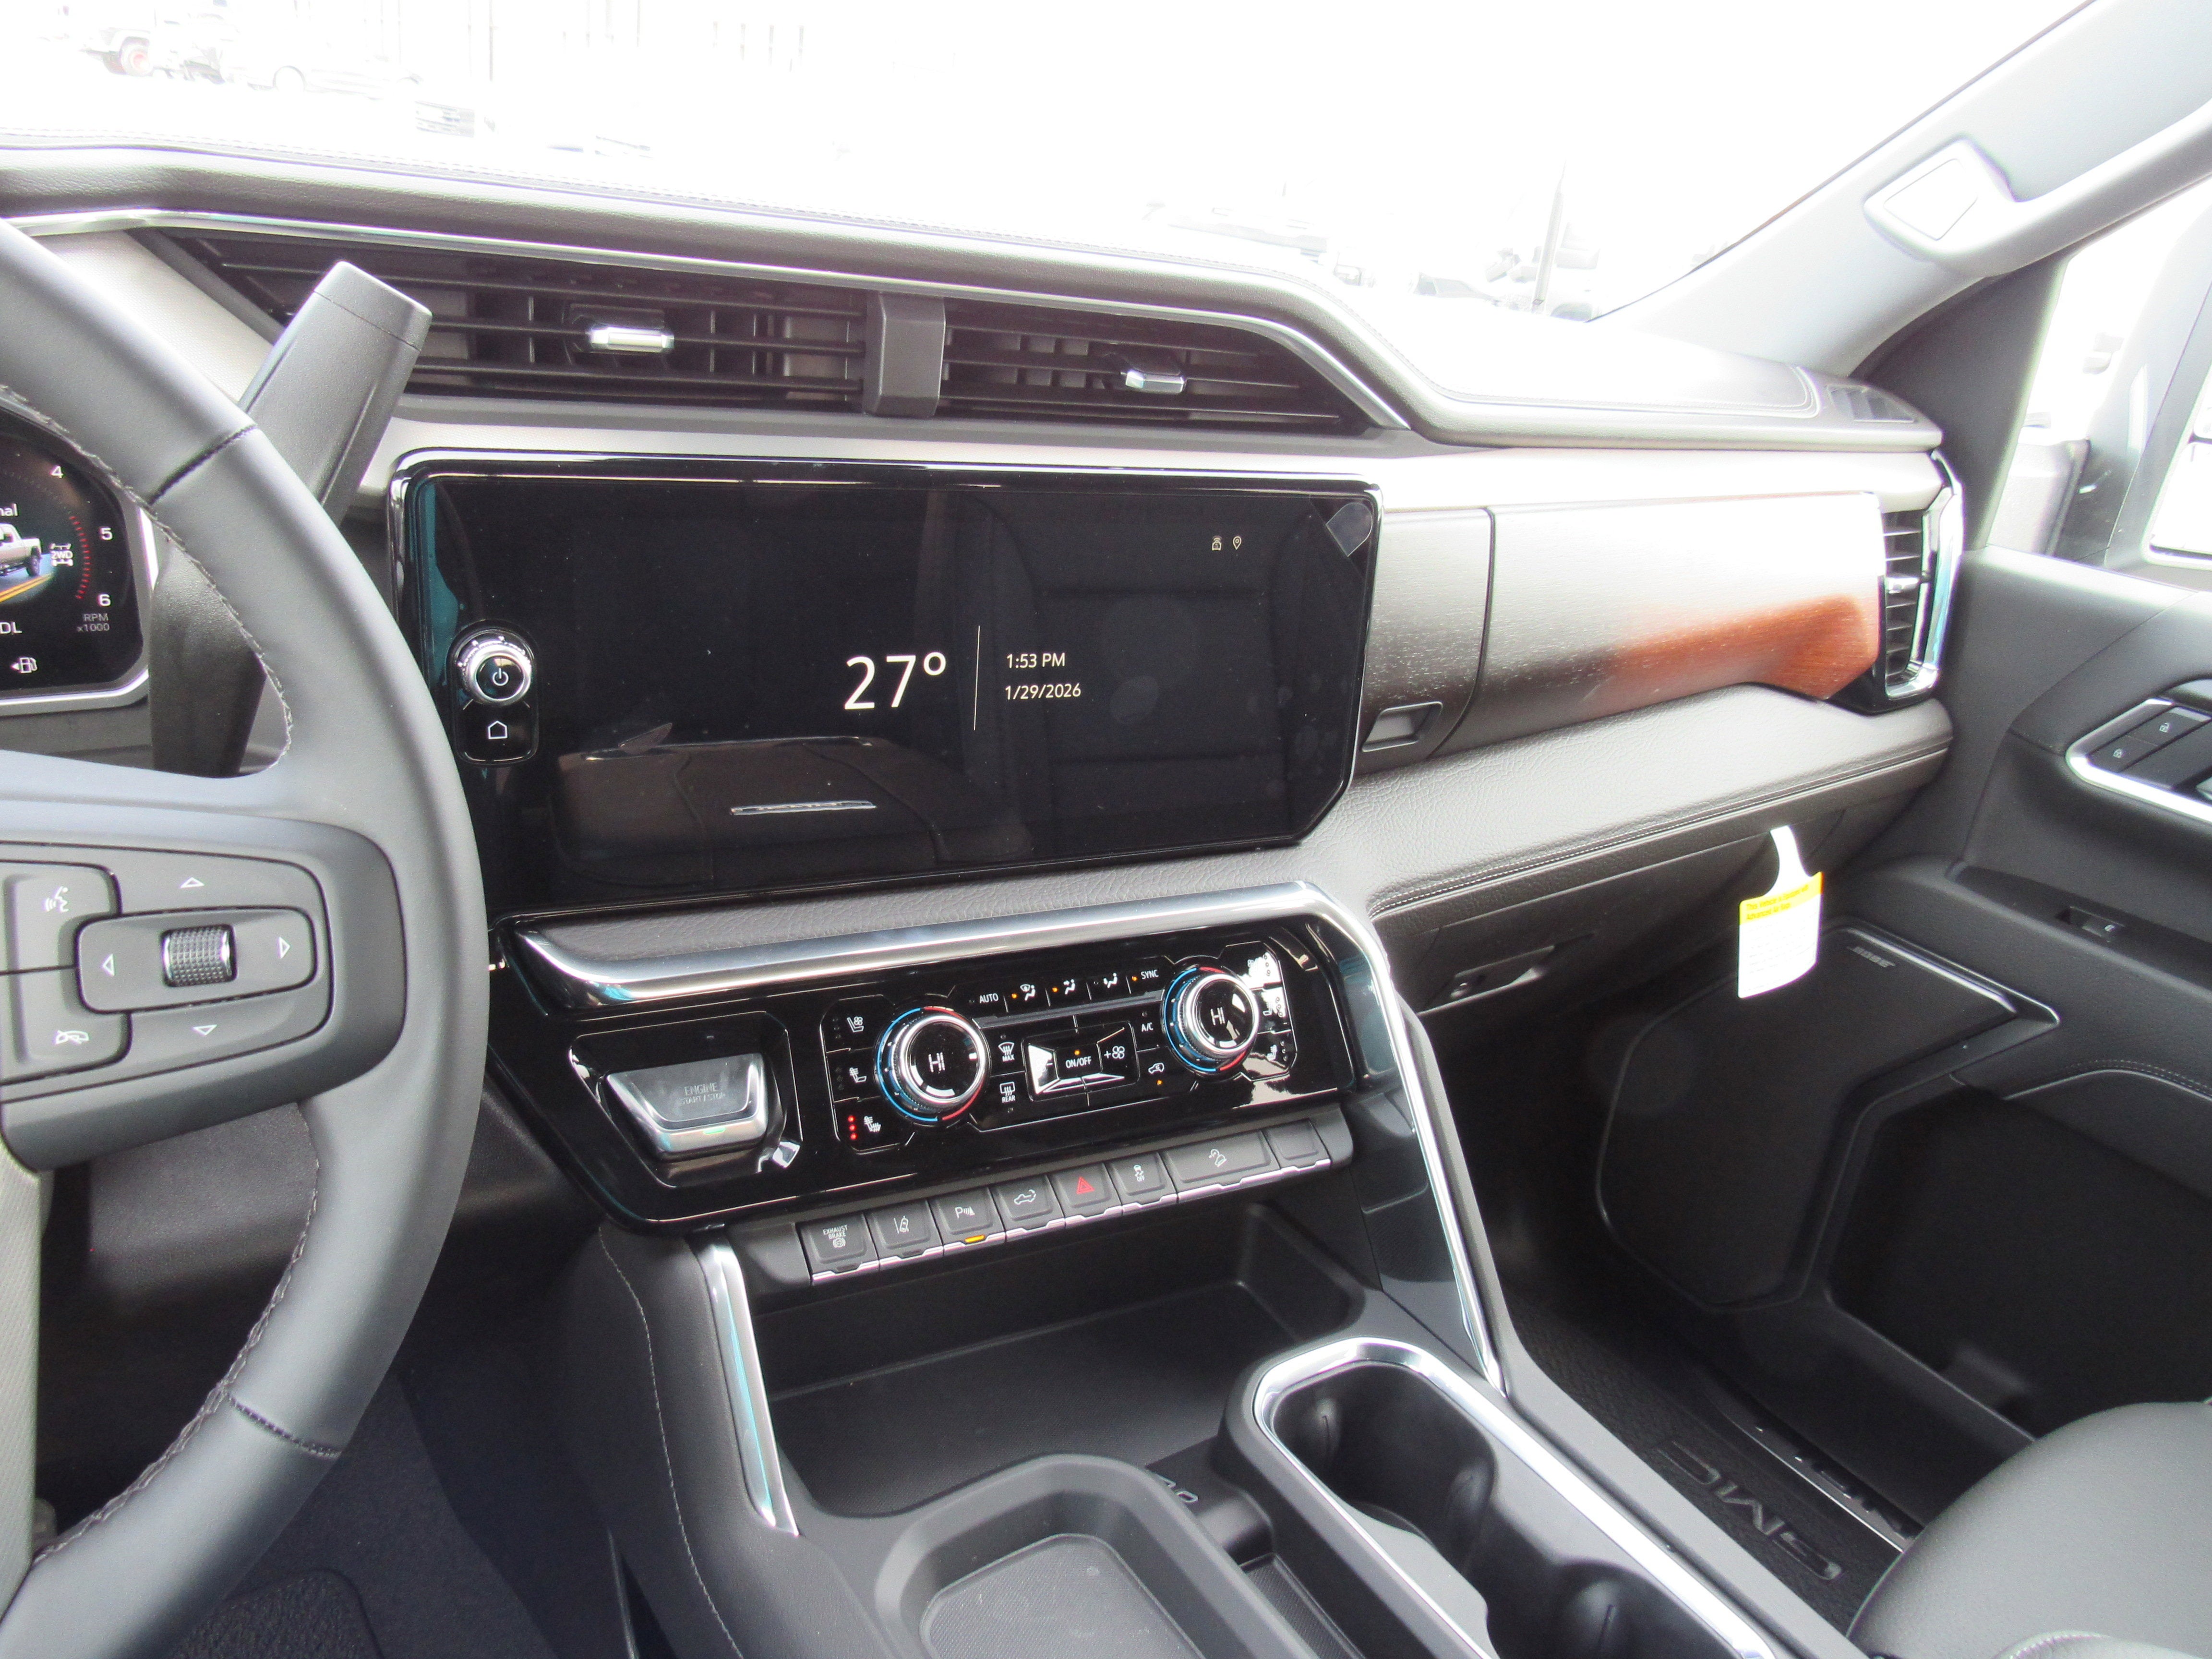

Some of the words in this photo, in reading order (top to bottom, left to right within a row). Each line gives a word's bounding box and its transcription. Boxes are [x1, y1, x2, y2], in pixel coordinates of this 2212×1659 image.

[51, 466, 63, 478] 4
[0, 503, 18, 517] al
[99, 528, 113, 541] 5
[51, 550, 73, 559] 2WD
[98, 594, 111, 607] 6
[83, 613, 109, 622] RPM
[77, 623, 110, 632] x1000
[1007, 654, 1037, 669] 1:53
[1042, 653, 1066, 667] PM
[1005, 683, 1082, 700] 1/29/2026
[1141, 970, 1159, 980] SYNC
[979, 993, 999, 1003] AUTO
[1141, 1022, 1154, 1032] A/C
[1002, 1054, 1015, 1062] MAX
[1065, 1056, 1092, 1069] ON/OFF
[684, 1082, 718, 1096] ENGINE
[1001, 1095, 1016, 1103] REAR
[823, 1225, 848, 1236] EXHAUST
[828, 1231, 846, 1240] BRAKE
